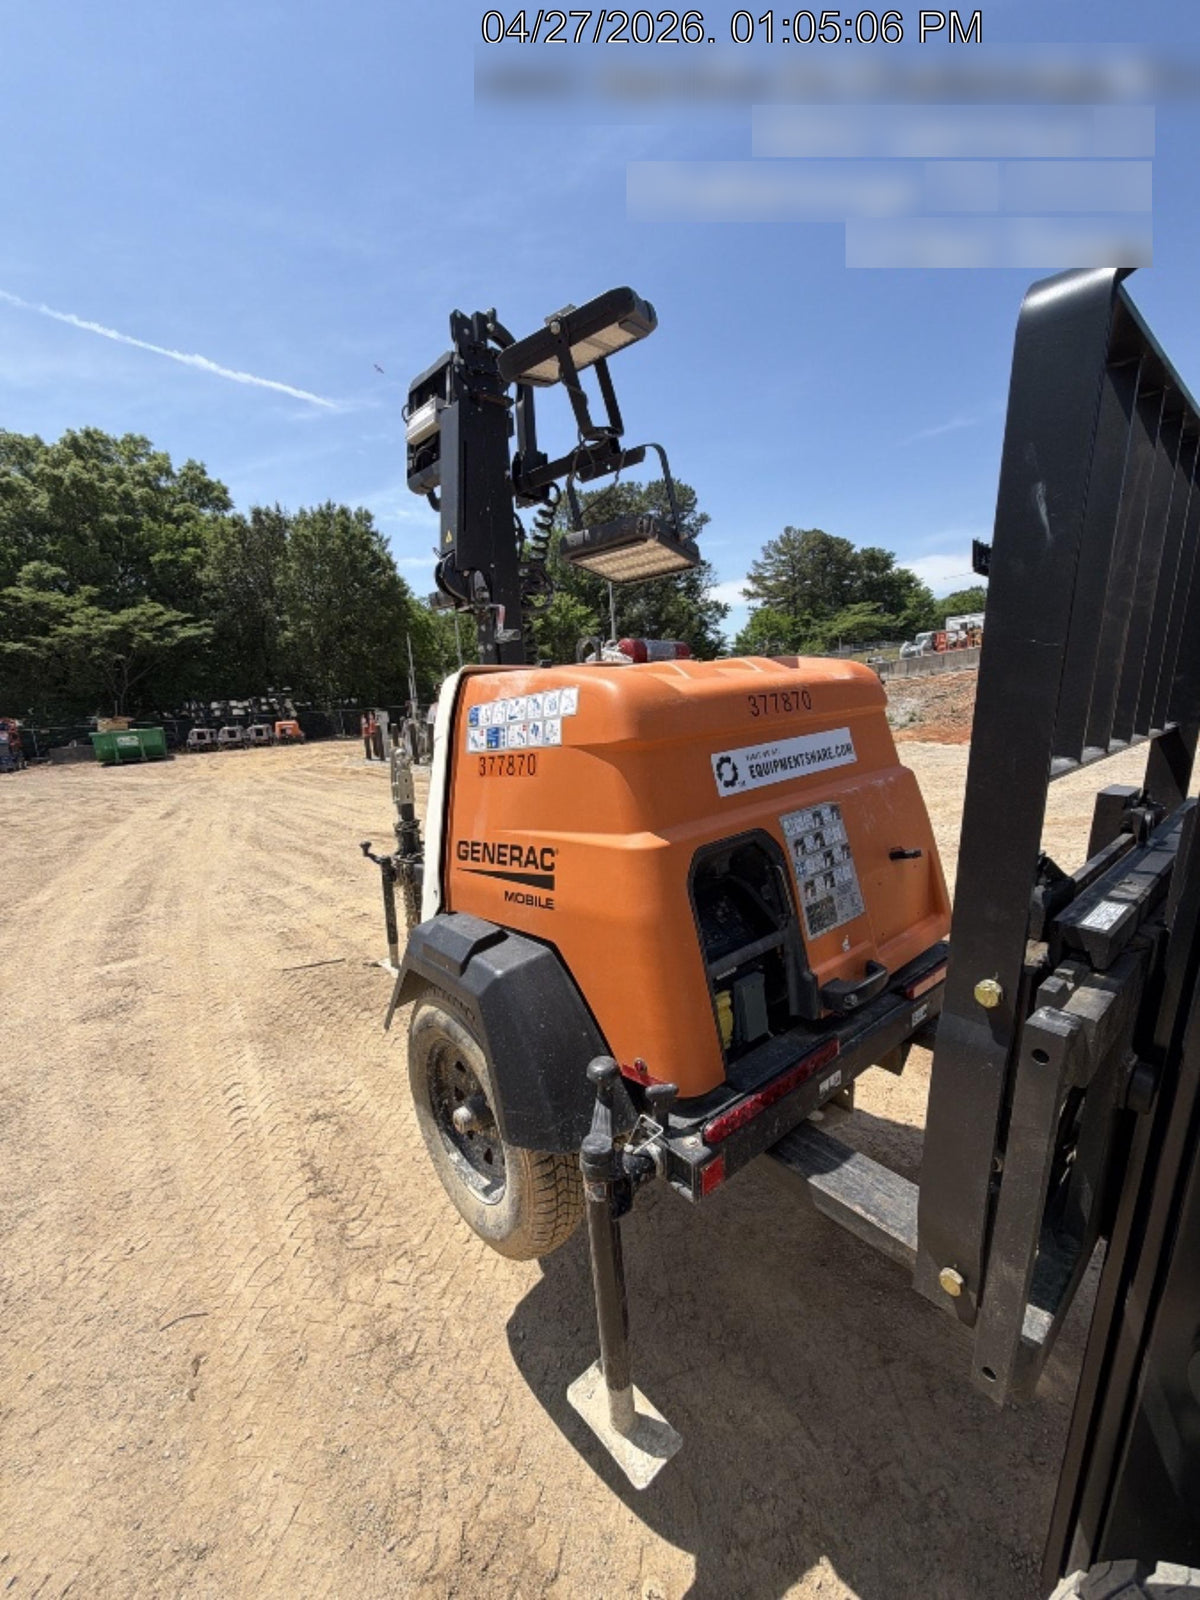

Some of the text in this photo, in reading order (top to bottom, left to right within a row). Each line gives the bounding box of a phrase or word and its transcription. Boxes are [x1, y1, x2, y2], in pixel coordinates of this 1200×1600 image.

[748, 690, 812, 717] 377870
[479, 753, 537, 777] 377870
[749, 742, 854, 779] EQUIPMENTSHARE.COM
[456, 840, 555, 872] GENERAC
[504, 890, 555, 910] MOBILE
